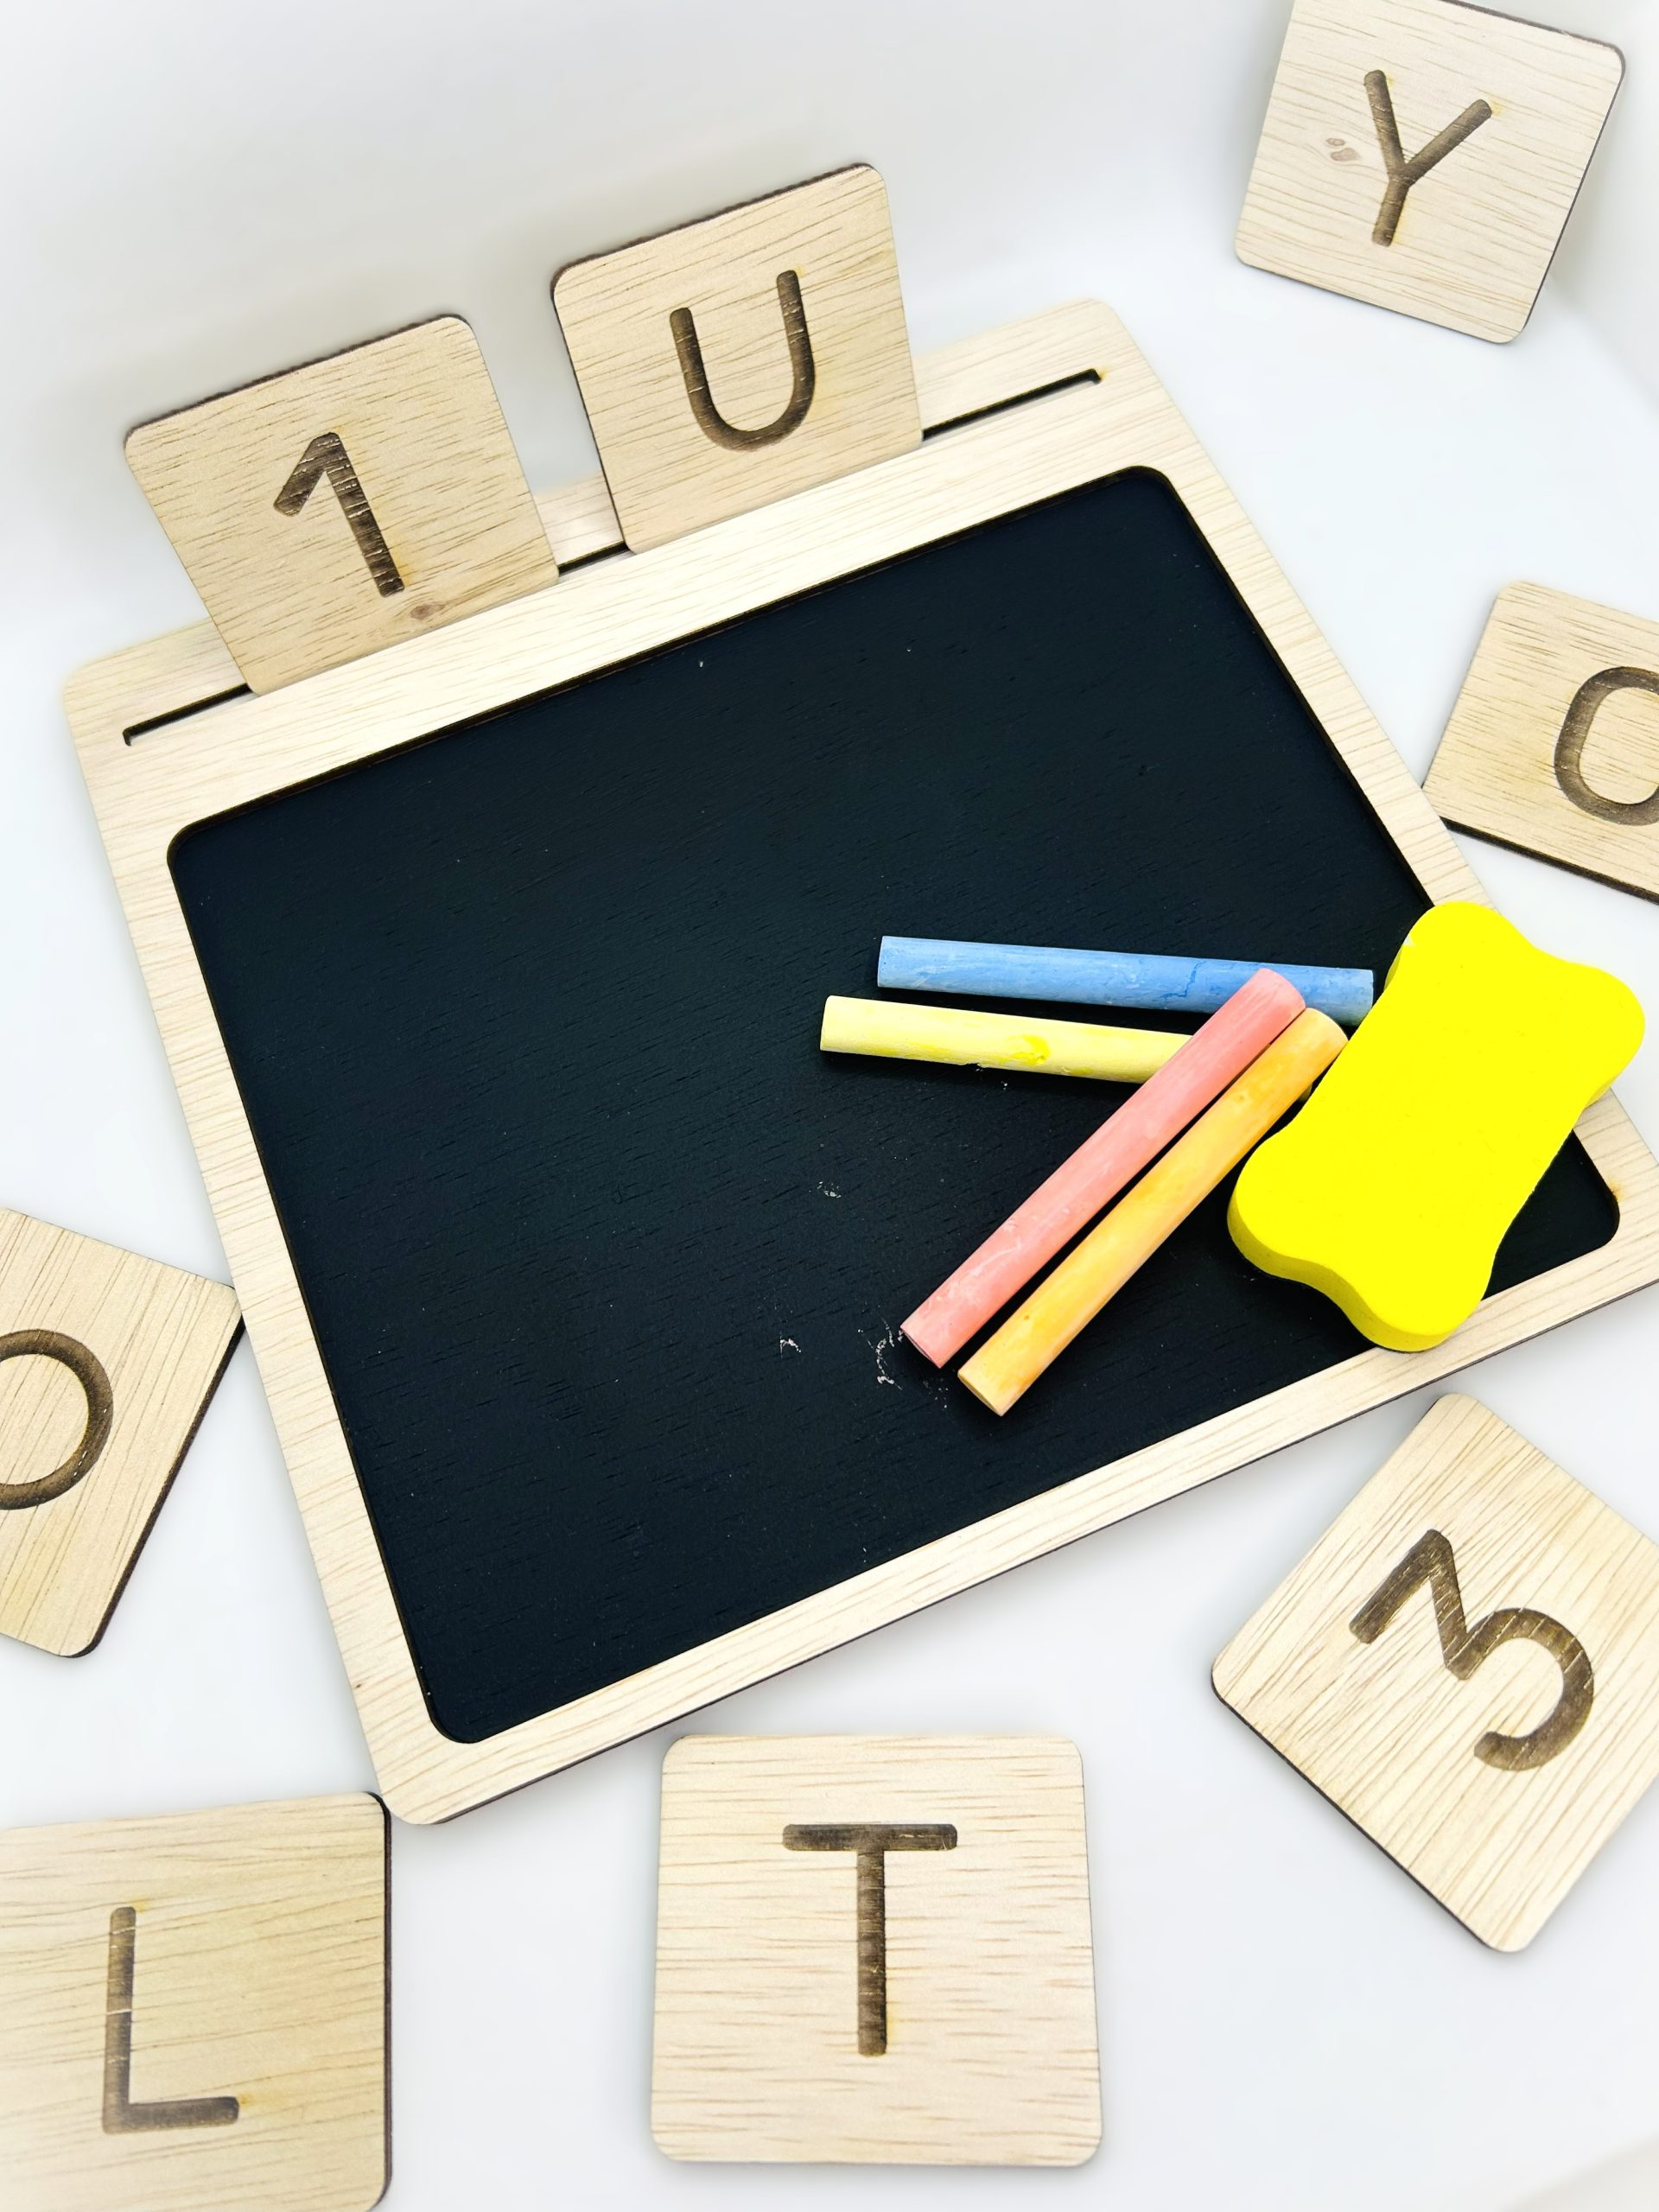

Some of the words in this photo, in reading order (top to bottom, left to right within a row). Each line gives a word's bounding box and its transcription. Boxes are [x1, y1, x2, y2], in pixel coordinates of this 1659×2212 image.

[1363, 69, 1492, 247] Y
[670, 270, 817, 451] U
[274, 432, 406, 598] 1
[1351, 1529, 1595, 1772] 3
[102, 1906, 240, 2133] L
[783, 1823, 958, 2057] T
